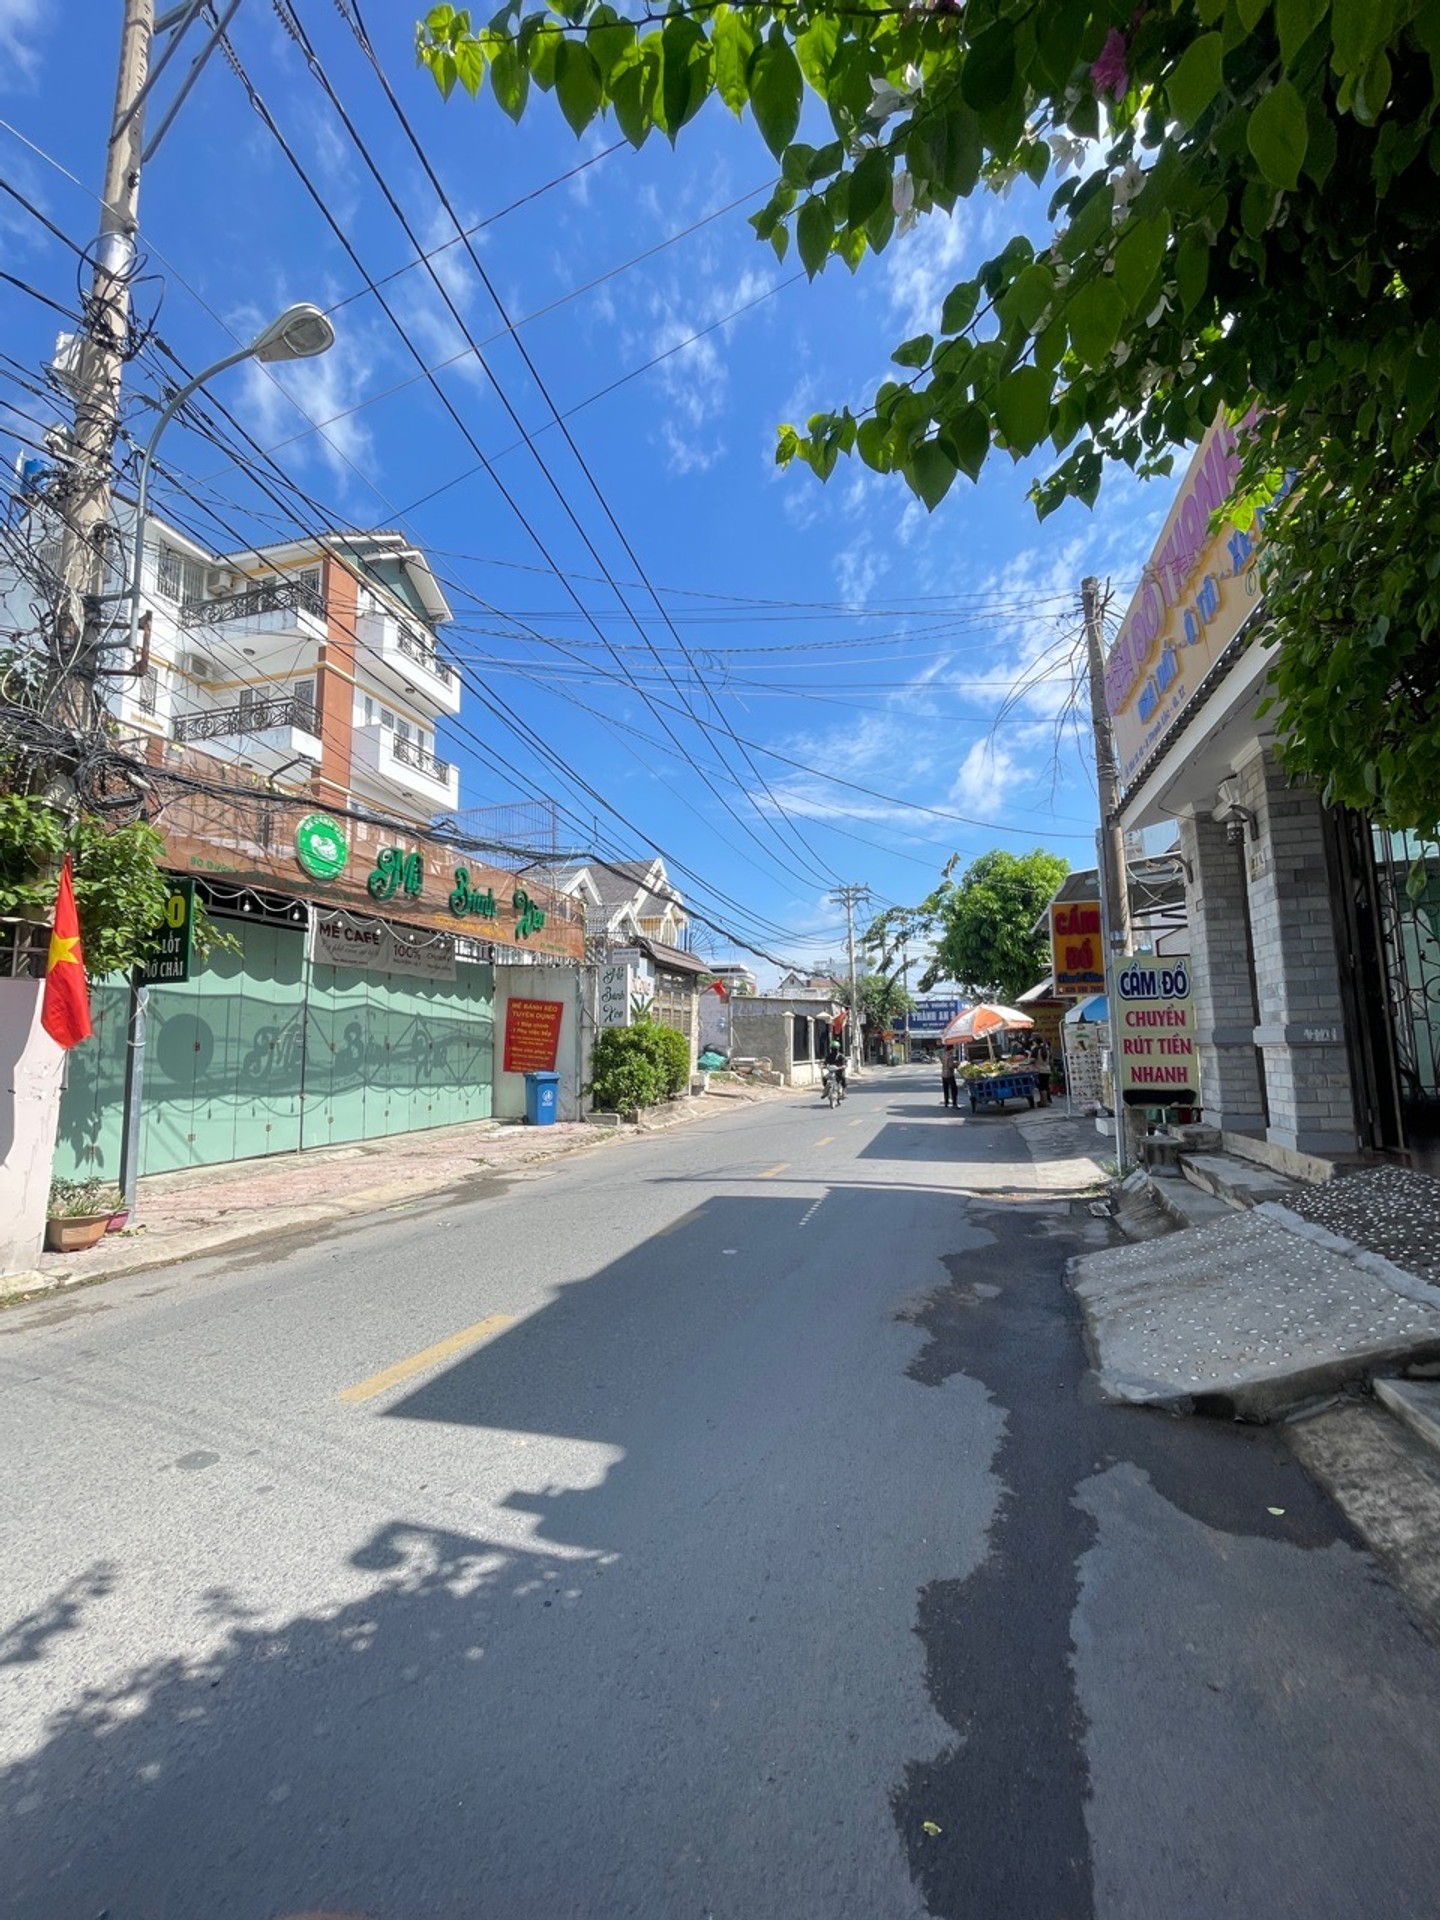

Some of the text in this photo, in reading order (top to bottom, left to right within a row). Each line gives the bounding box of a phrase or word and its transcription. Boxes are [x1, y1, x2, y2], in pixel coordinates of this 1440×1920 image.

[162, 930, 182, 954] LỐT
[160, 957, 184, 978] CHÀI
[1120, 960, 1188, 997] CẦM ĐỒ
[1123, 1032, 1193, 1055] RÚT TIỀN
[1130, 1066, 1189, 1083] NHANH
